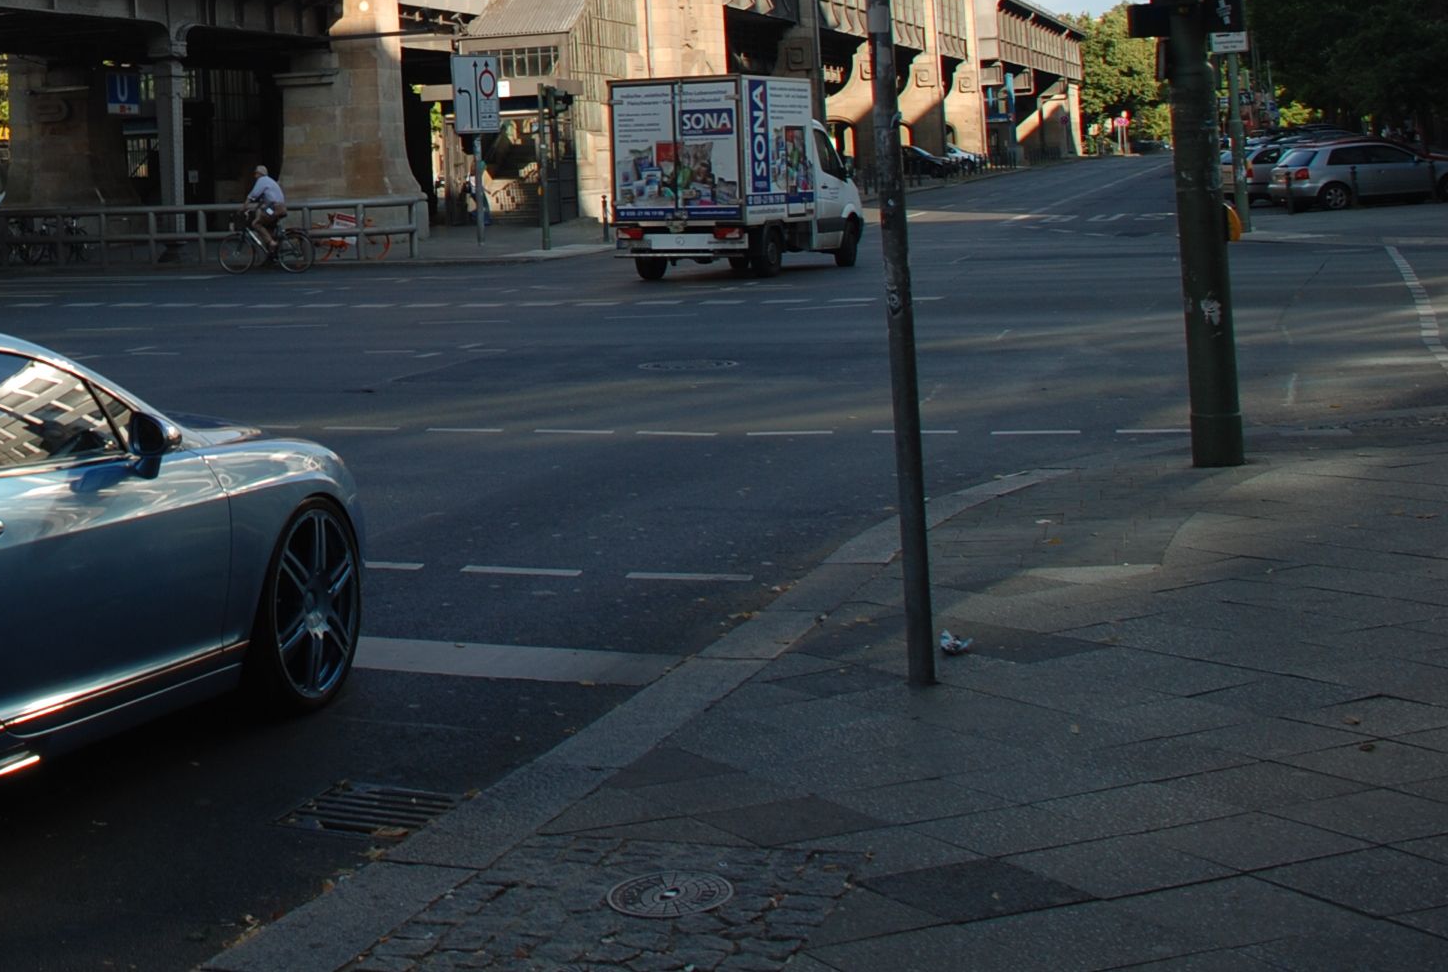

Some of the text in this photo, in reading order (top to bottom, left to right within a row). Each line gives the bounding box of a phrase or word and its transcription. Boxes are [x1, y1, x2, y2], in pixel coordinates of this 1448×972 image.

[116, 75, 129, 103] U
[682, 112, 732, 130] SONA
[752, 85, 767, 177] SONA
